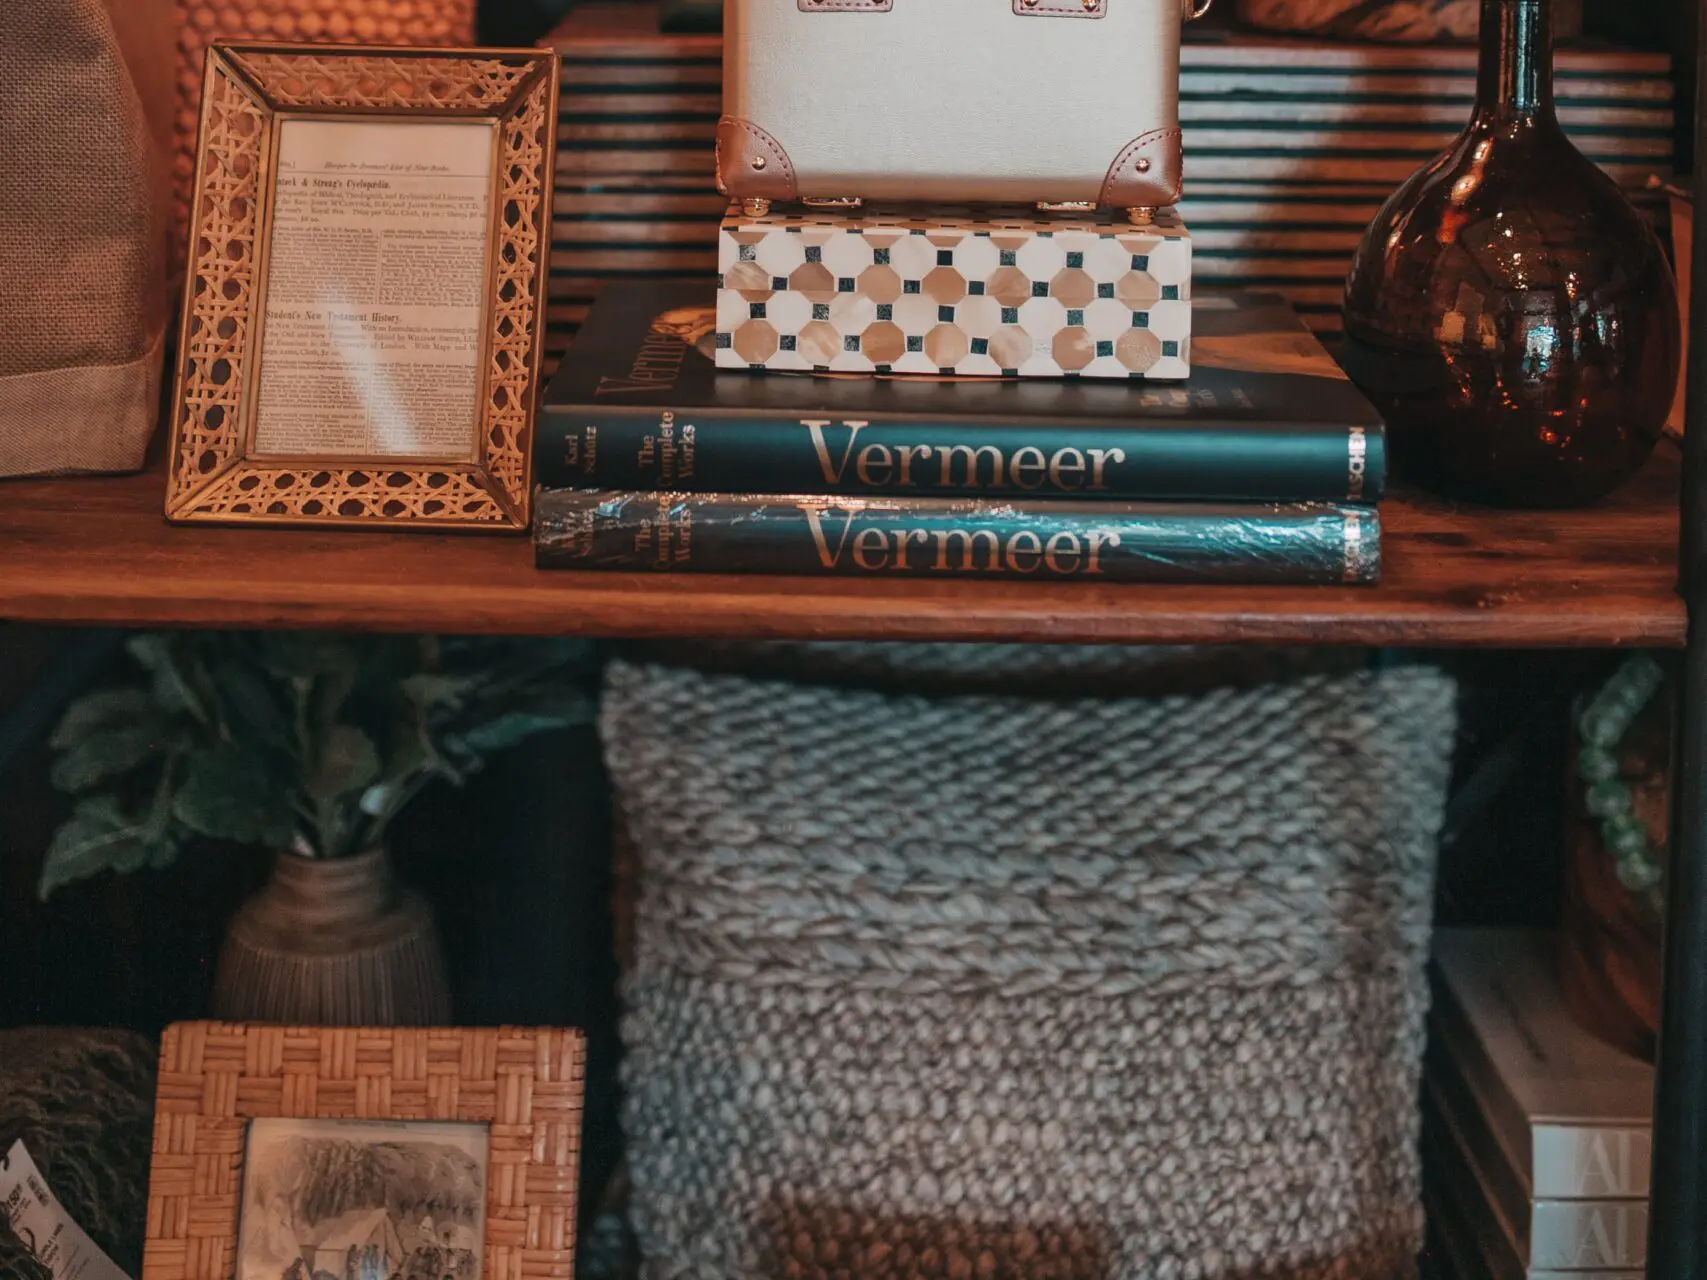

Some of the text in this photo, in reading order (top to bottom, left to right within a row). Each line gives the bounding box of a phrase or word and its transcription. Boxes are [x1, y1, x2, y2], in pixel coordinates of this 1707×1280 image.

[594, 331, 686, 396] Verme
[638, 435, 655, 468] The
[657, 411, 678, 487] Complete
[678, 424, 696, 478] Works
[799, 419, 1126, 491] Vermeer
[796, 503, 1121, 574] Vermeer
